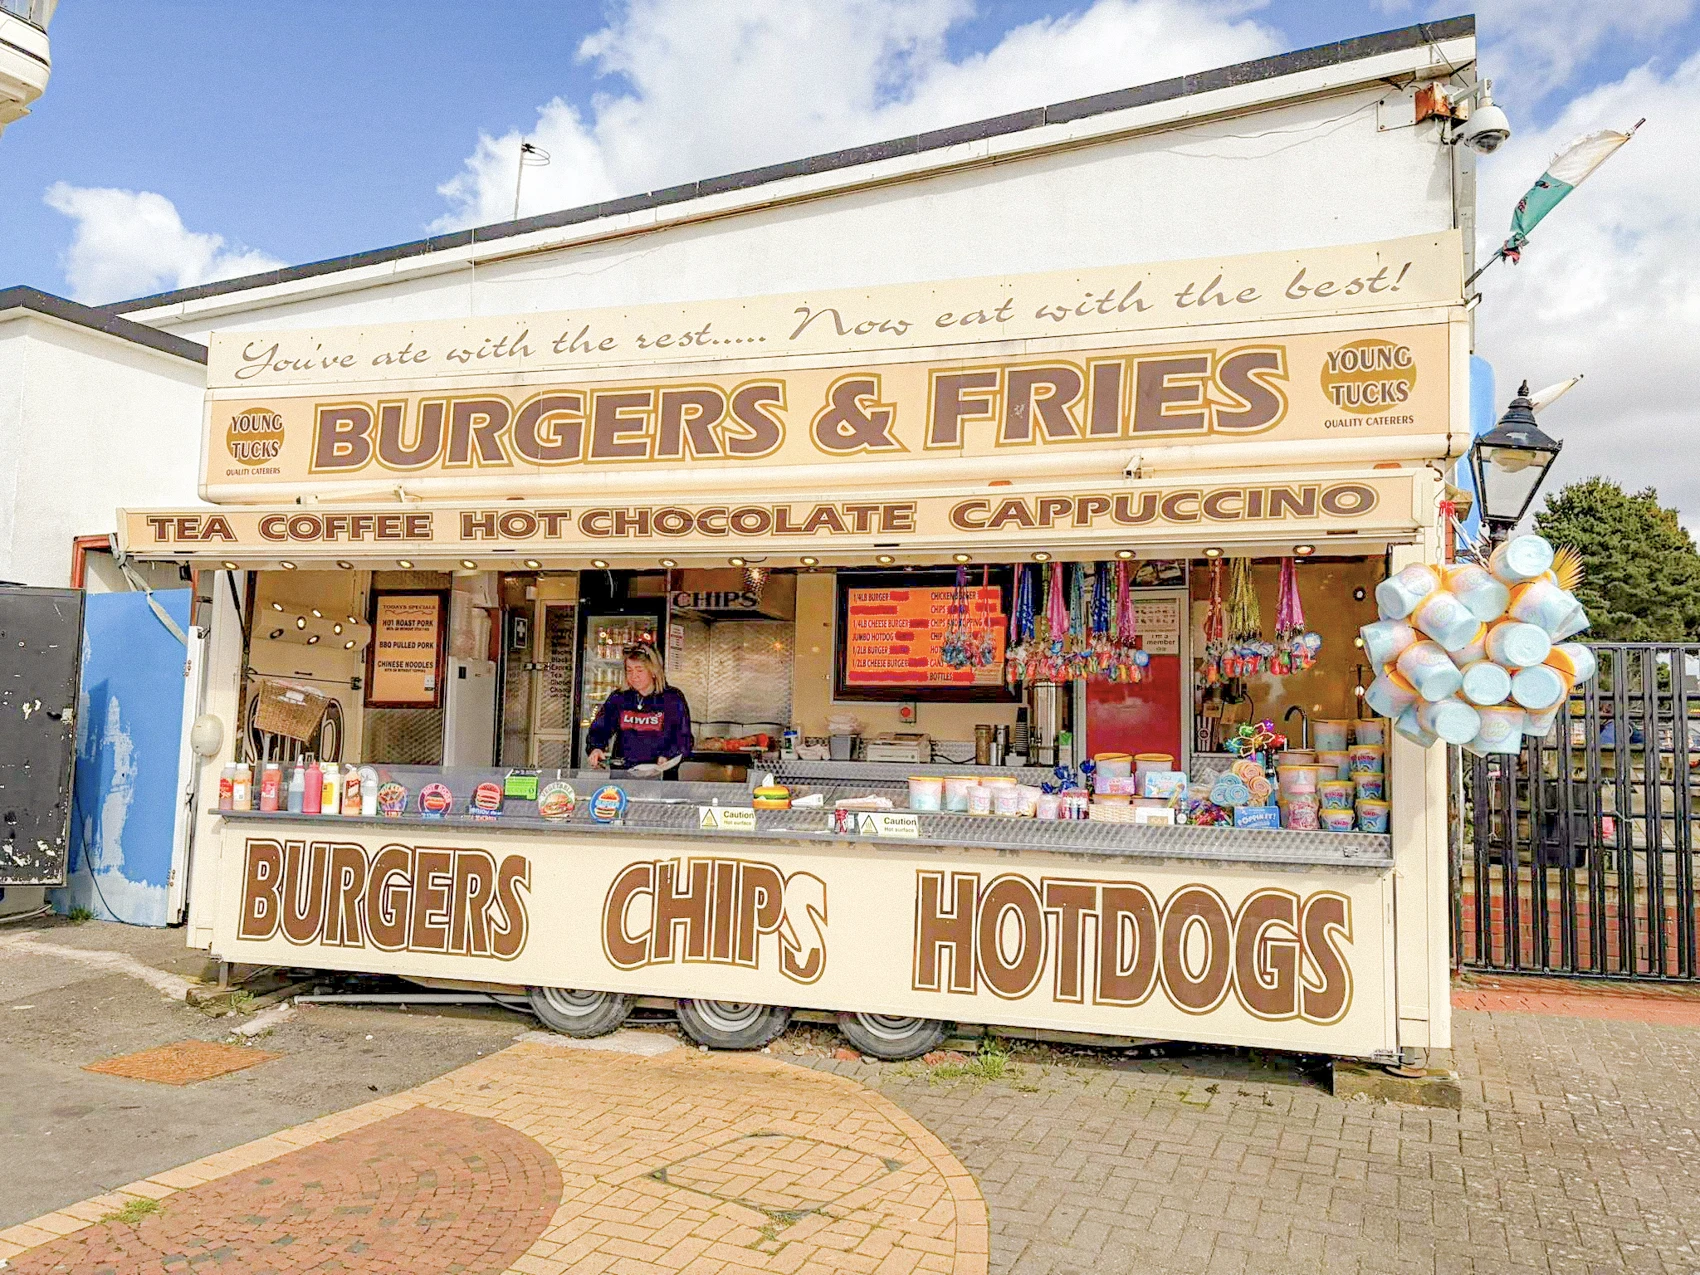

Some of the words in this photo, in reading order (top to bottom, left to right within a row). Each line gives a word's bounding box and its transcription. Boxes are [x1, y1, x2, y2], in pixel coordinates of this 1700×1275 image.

[234, 339, 359, 381] You've
[371, 342, 430, 366] ate
[446, 329, 534, 362] with
[552, 322, 618, 354] the
[788, 306, 914, 341] Now
[934, 299, 1015, 328] eat
[1035, 280, 1153, 323] with
[1174, 272, 1262, 307] the
[1285, 262, 1412, 300] best!
[1326, 346, 1413, 372] YOUNG
[1330, 381, 1409, 406] TUCKS
[307, 378, 788, 475] BURGERS
[810, 373, 910, 455] &
[923, 345, 1290, 451] FRIES
[231, 413, 283, 432] YOUNG
[1324, 418, 1363, 429] QUALITY
[1366, 415, 1415, 426] CATERERS
[231, 441, 279, 459] TUCKS
[226, 468, 250, 477] QUALITY
[251, 467, 281, 475] CATERERS
[146, 514, 238, 543] TEA
[257, 509, 434, 542] COFFEE
[460, 508, 573, 540] HOT
[578, 500, 917, 537] CHOCOLATE
[948, 481, 1381, 534] CAPPUCCINO
[672, 591, 757, 607] CHIPS
[868, 592, 890, 602] BURGER
[930, 591, 953, 600] CHICKEN
[930, 605, 946, 614] CHIPS
[396, 619, 416, 627] ROAST
[416, 619, 434, 627] PORK
[868, 619, 888, 628] CHEESE
[887, 619, 909, 628] BURGER
[930, 619, 946, 627] CHIPS
[852, 632, 871, 641] JUMBO
[871, 632, 895, 641] HOTDOG
[393, 641, 416, 649] PULLED
[417, 641, 434, 649] PORK
[867, 645, 889, 655] BURGER
[377, 660, 404, 668] CHINESE
[404, 661, 434, 669] NOODLES
[868, 659, 887, 668] CHEESE
[887, 659, 909, 668] BURGER
[929, 672, 952, 681] BOTTLES
[723, 810, 755, 819] Caution
[884, 816, 917, 826] Caution
[236, 836, 532, 961] BURGERS
[601, 856, 829, 986] CHIPS
[911, 869, 1354, 1027] HOTDOGS
